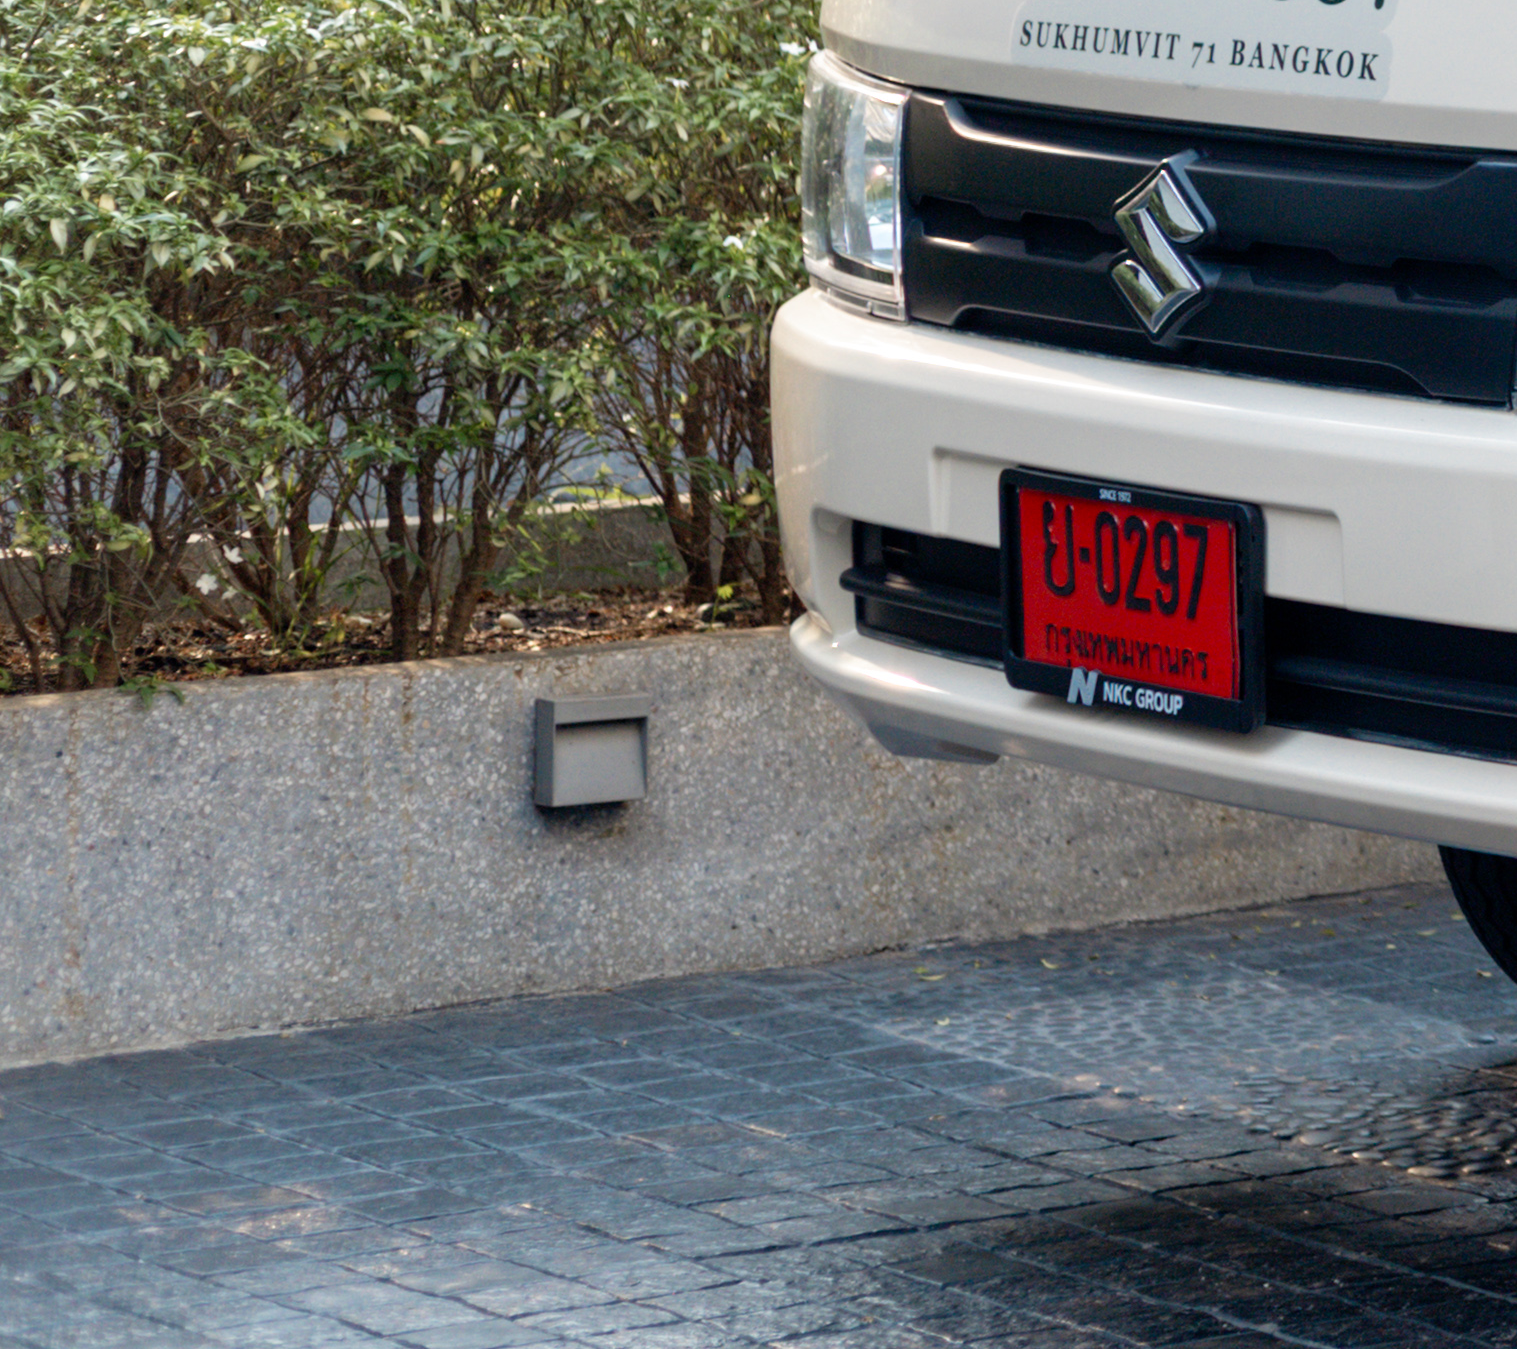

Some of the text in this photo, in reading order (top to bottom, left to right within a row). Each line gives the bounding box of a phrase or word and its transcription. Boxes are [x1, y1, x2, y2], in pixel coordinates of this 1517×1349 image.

[1019, 20, 1380, 81] SUKHUMVIT 71 BANGKOK
[1099, 488, 1116, 501] SINCE
[1045, 623, 1208, 679] กรุงเทพมหานคร
[1102, 681, 1133, 707] NKC
[1134, 687, 1184, 716] GROUP
